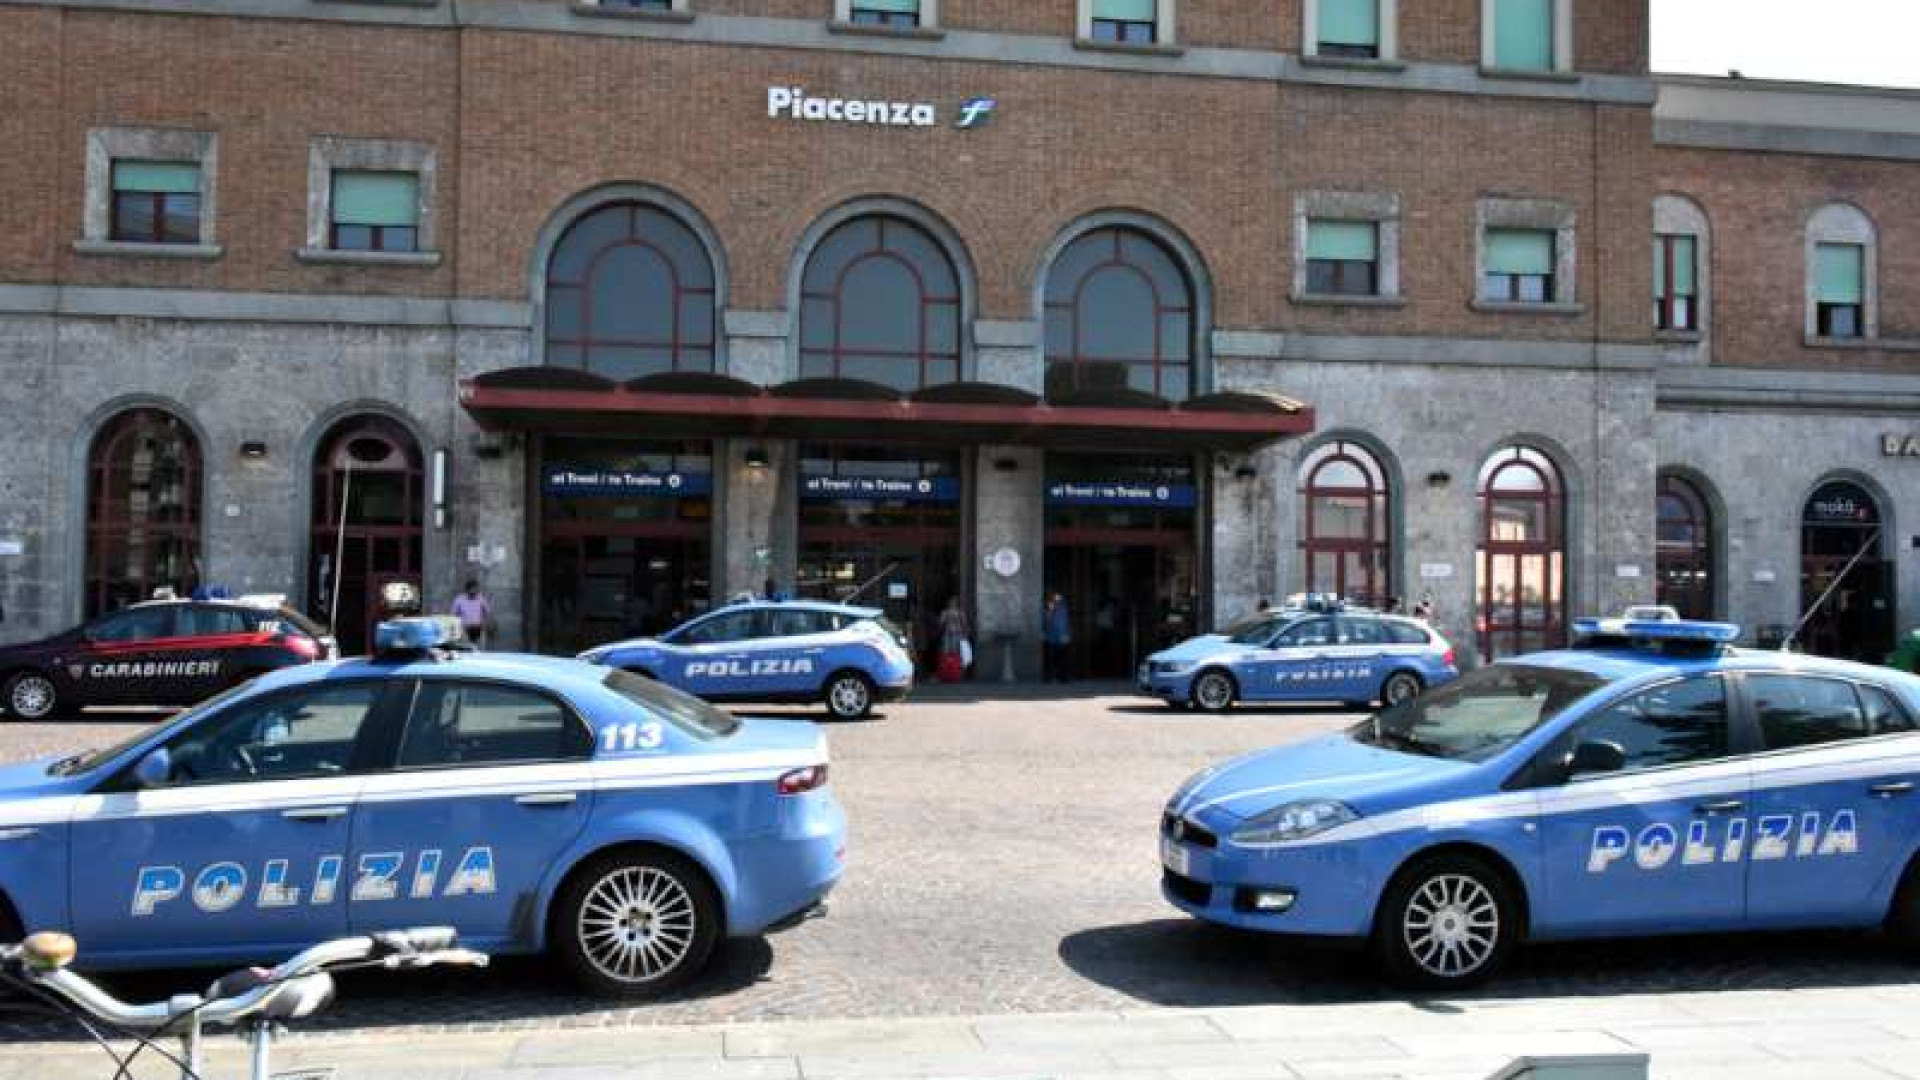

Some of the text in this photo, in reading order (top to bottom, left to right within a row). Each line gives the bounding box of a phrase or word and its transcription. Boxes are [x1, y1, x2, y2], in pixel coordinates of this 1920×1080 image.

[767, 85, 935, 125] Piacenza
[624, 473, 661, 486] Trains
[90, 659, 220, 679] CARABINIERI
[685, 658, 814, 678] POLIZIA
[601, 721, 664, 750] 113
[1587, 808, 1860, 873] POLIZIA
[131, 845, 499, 916] POLIZIA
